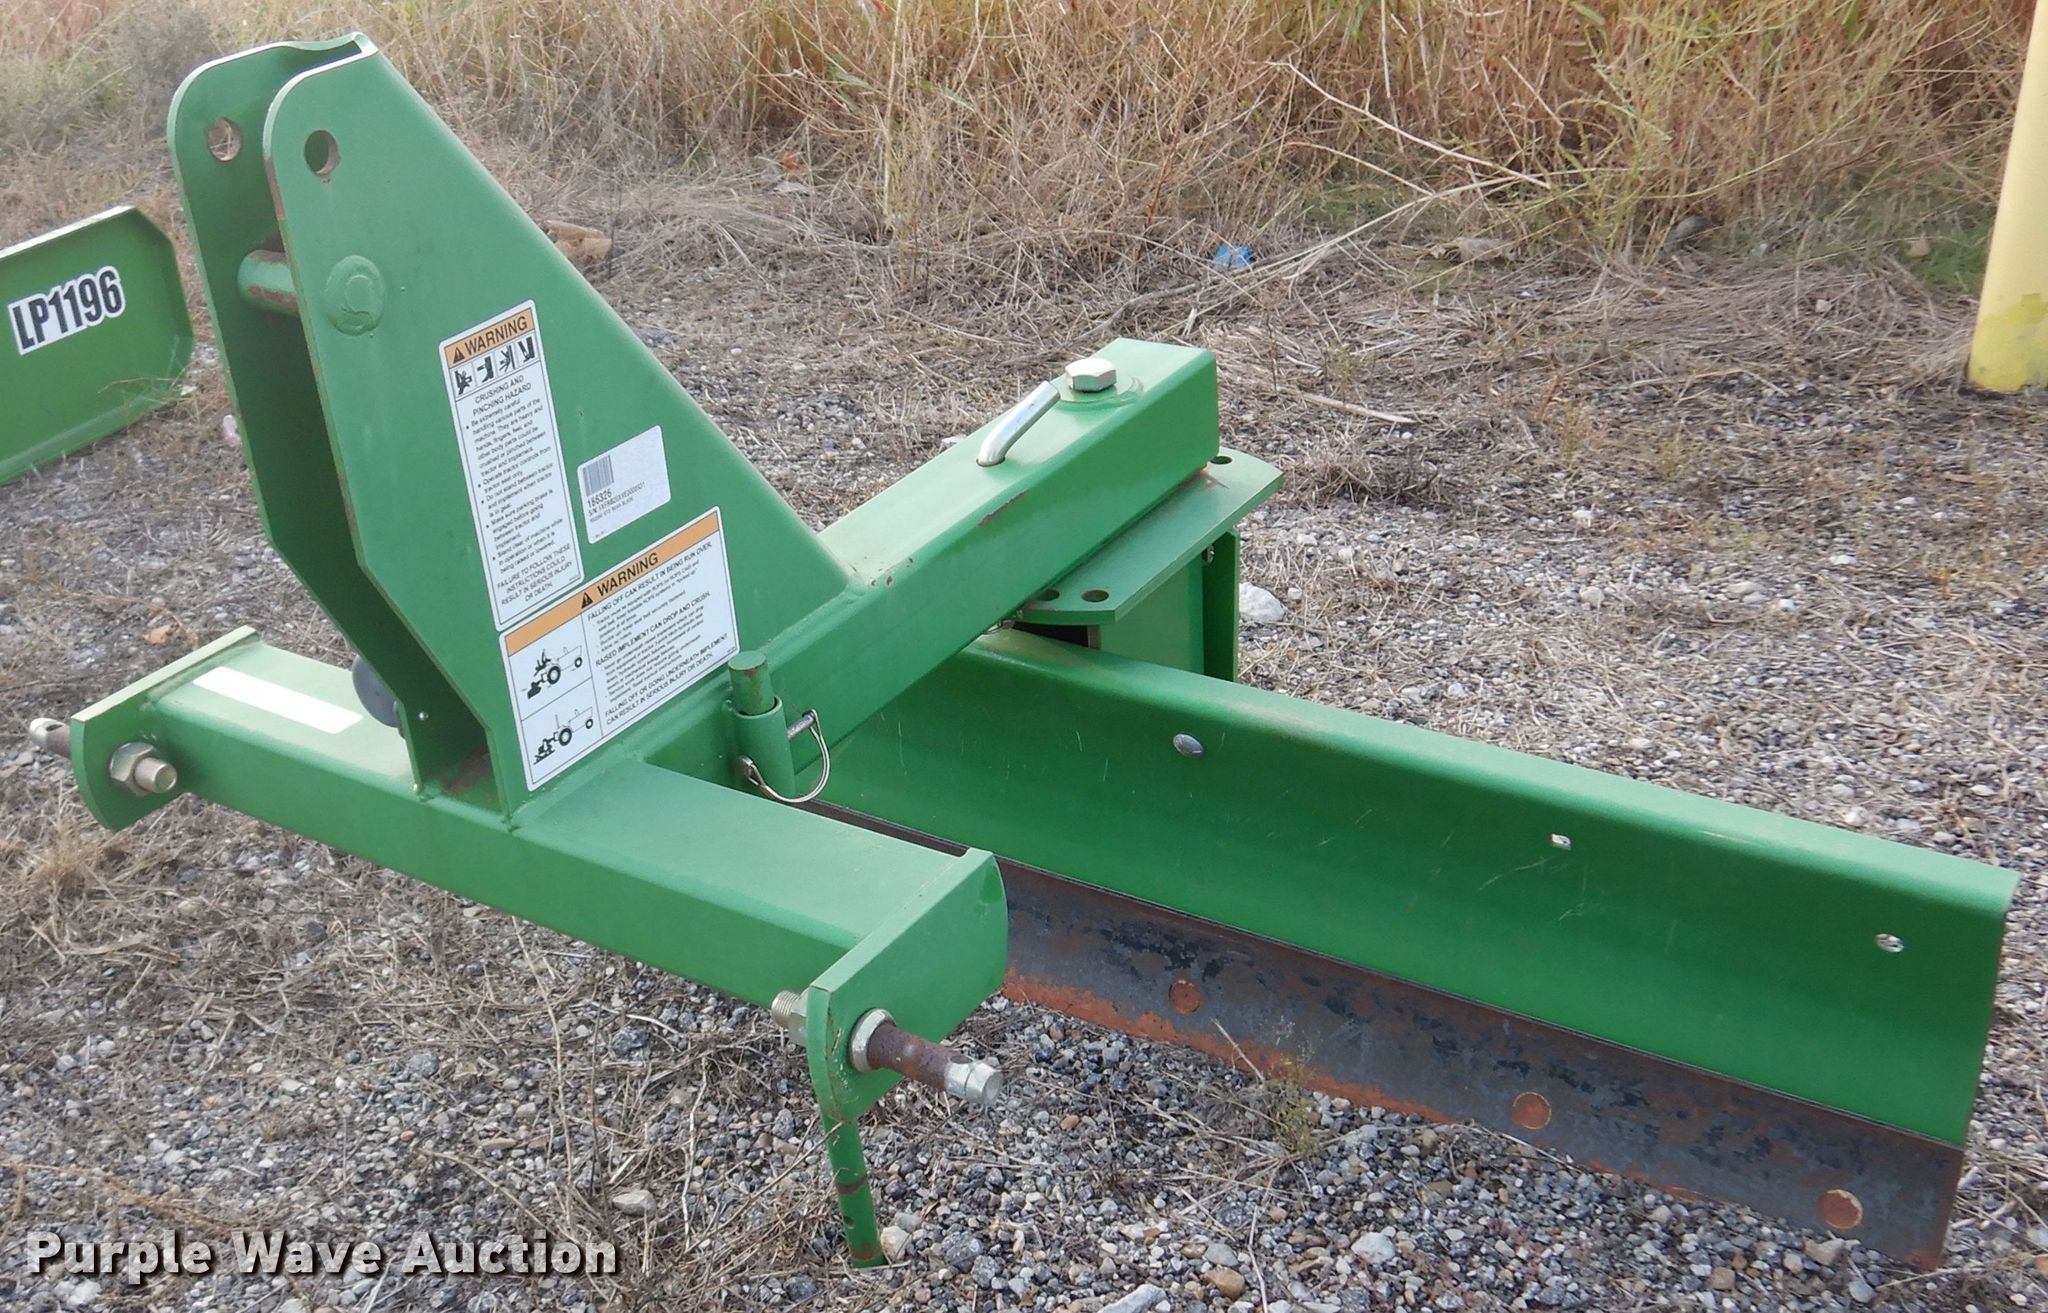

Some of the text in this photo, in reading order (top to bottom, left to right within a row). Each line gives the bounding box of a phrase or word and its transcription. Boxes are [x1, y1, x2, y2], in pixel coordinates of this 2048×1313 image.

[12, 270, 122, 349] LP1196
[464, 314, 527, 356] WARNING
[472, 381, 531, 417] PINCHING HAZARD
[474, 374, 524, 404] CRUSHING AND
[597, 550, 658, 597] WARNING
